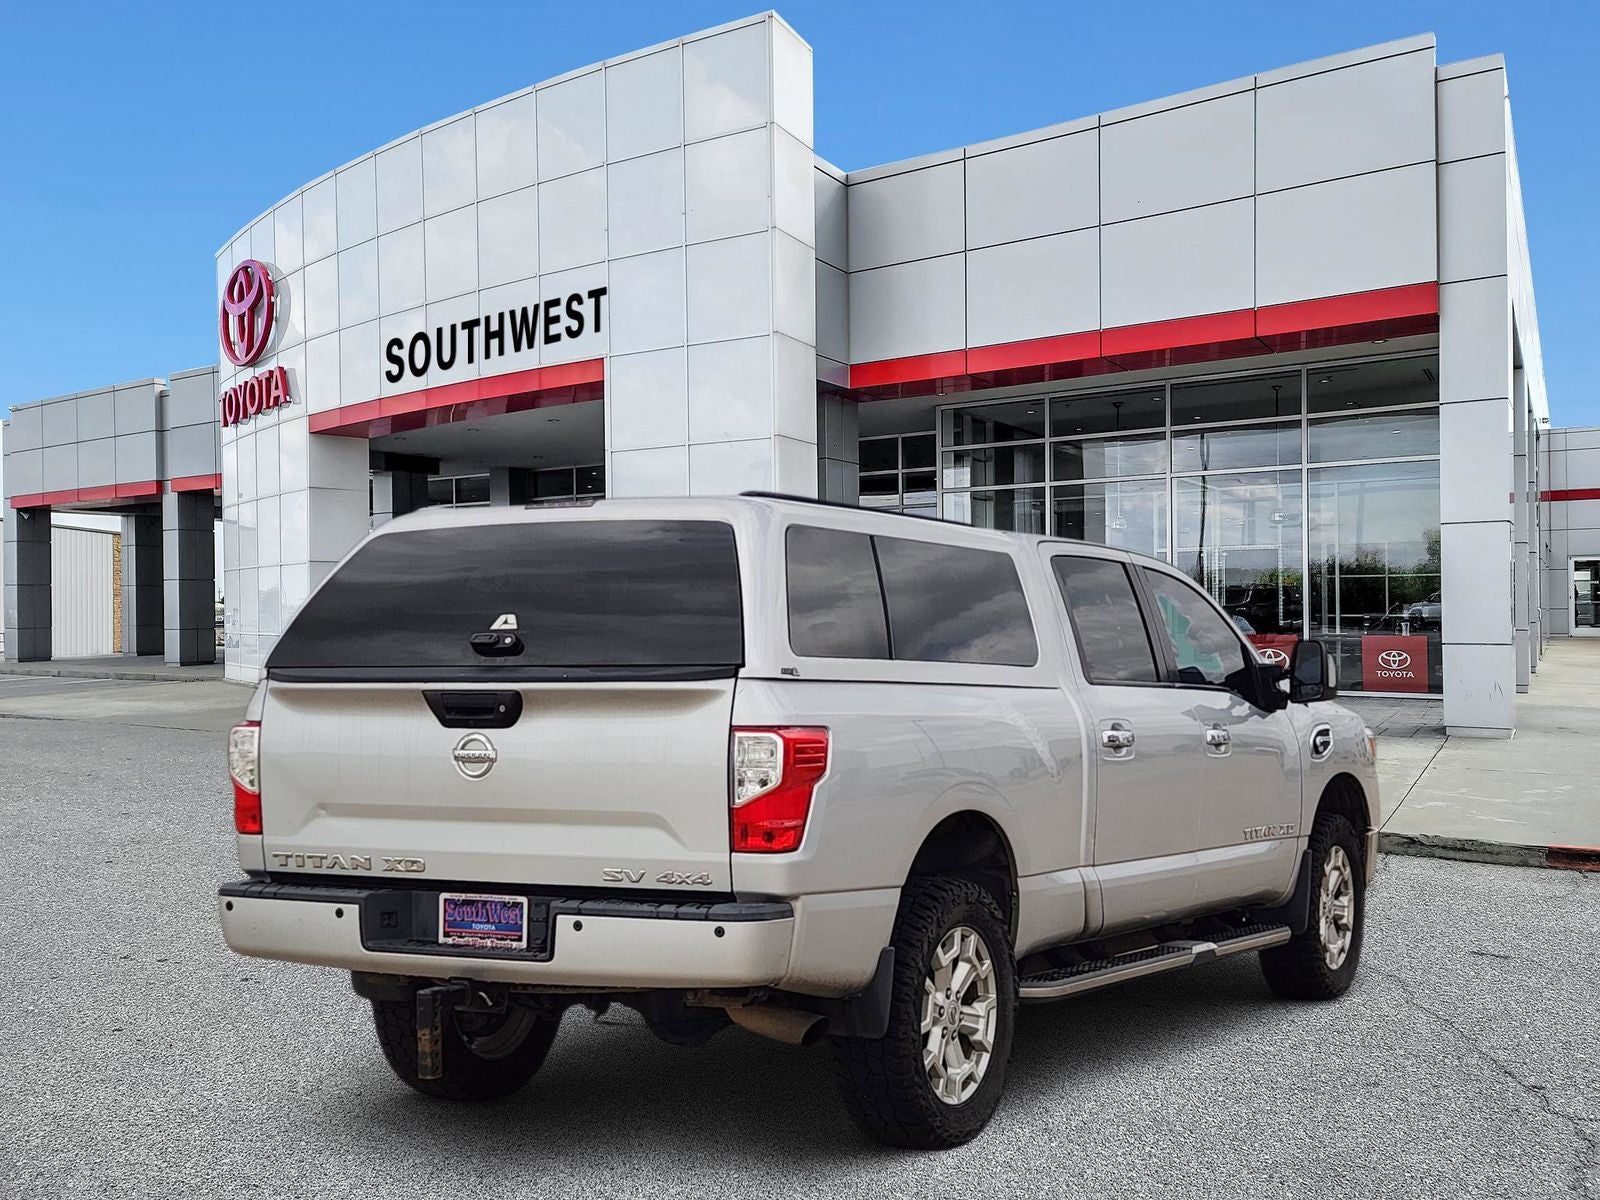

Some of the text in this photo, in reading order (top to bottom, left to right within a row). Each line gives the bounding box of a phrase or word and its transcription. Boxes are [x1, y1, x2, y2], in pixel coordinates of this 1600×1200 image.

[385, 287, 607, 383] SOUTHWEST
[219, 366, 291, 427] TOYOTA
[1375, 670, 1414, 679] TOYOTA
[456, 752, 490, 760] NISSAN
[272, 851, 426, 873] TITAN XD
[602, 867, 647, 883] SV
[471, 923, 496, 931] TOYOTA
